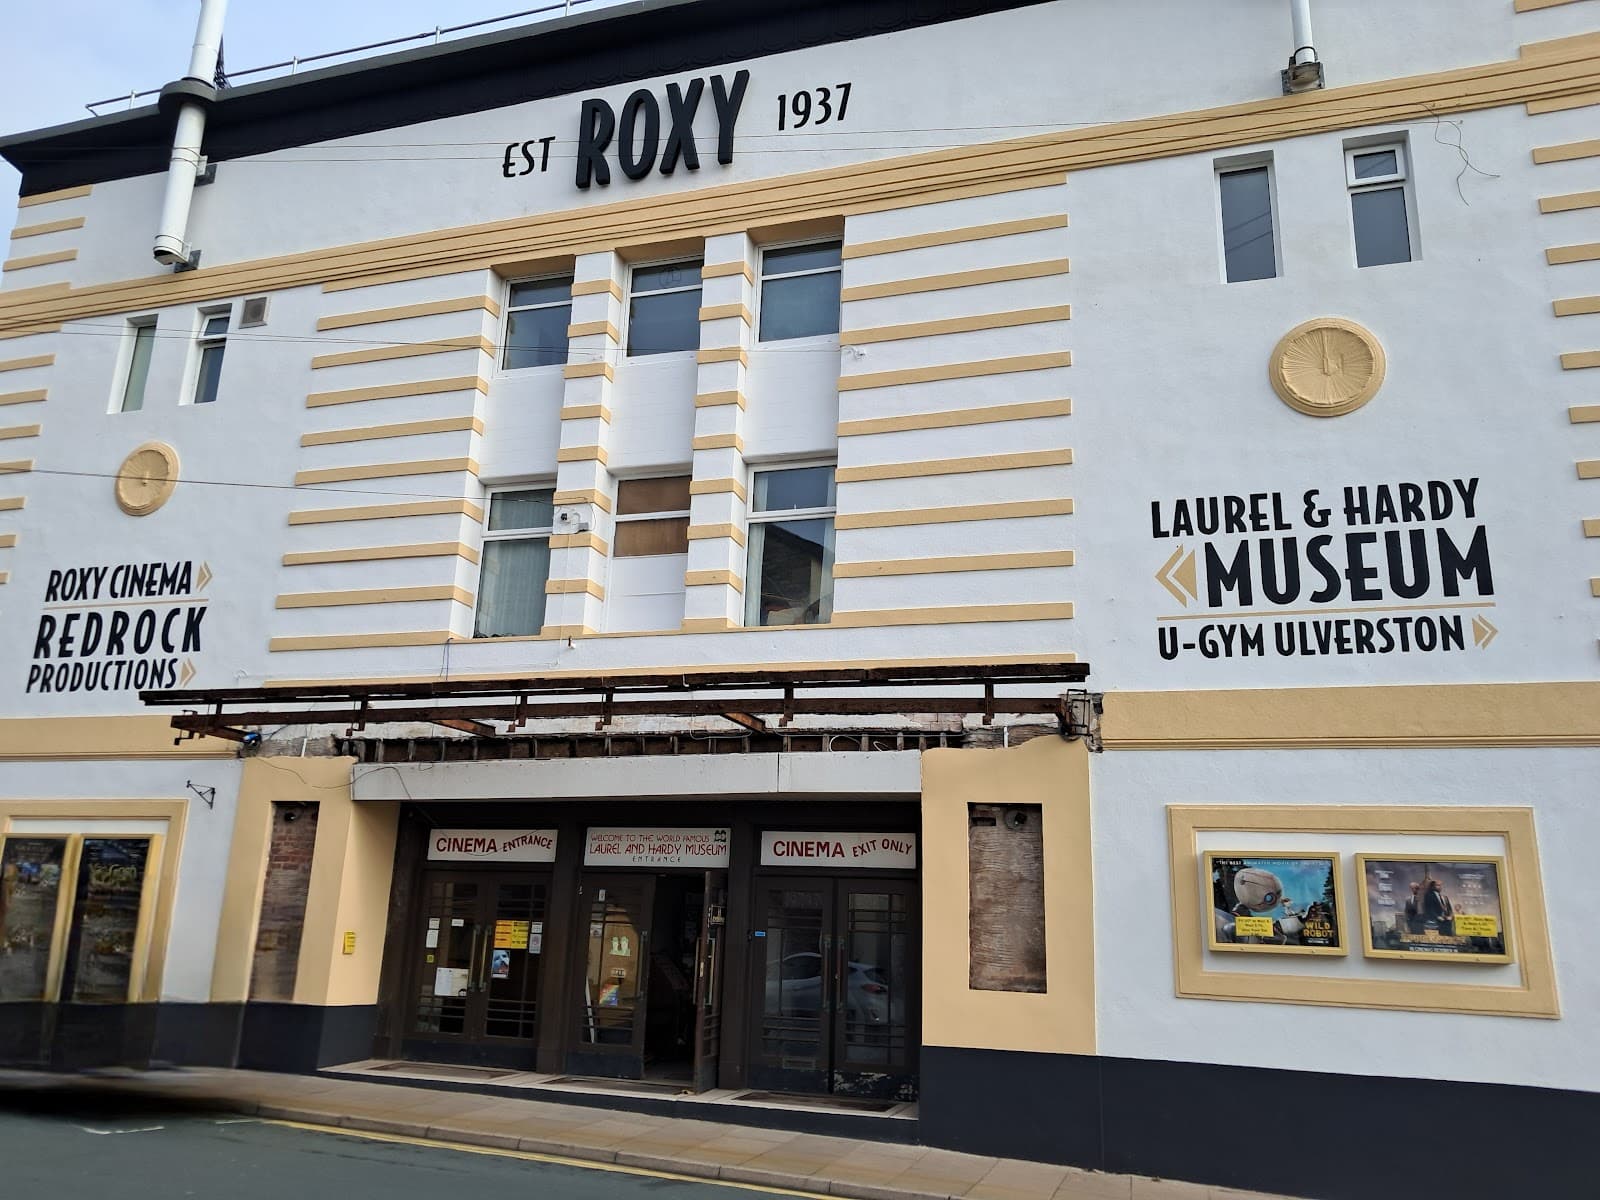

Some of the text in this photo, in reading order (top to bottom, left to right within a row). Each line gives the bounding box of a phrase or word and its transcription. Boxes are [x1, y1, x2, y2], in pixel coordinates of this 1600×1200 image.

[502, 69, 851, 189] EST ROXY 1937
[1151, 477, 1479, 538] LAUREL & HARDY
[45, 561, 192, 602] ROXY CINEMA
[1204, 525, 1494, 607] MUSEUM
[33, 607, 207, 659] REDROCK
[1158, 615, 1465, 660] U-GYM ULVERSTON
[26, 658, 178, 693] PRODUCTIONS
[436, 835, 553, 853] CINEMA ENTRANCE
[590, 843, 727, 856] LAUREL AND HARDY MUSEUM
[591, 834, 623, 842] WELCOME
[683, 835, 710, 843] FAMOUS
[773, 838, 913, 858] CINEMA EXIT ONLY
[1303, 929, 1335, 939] ROBOT
[1304, 920, 1331, 931] WILD
